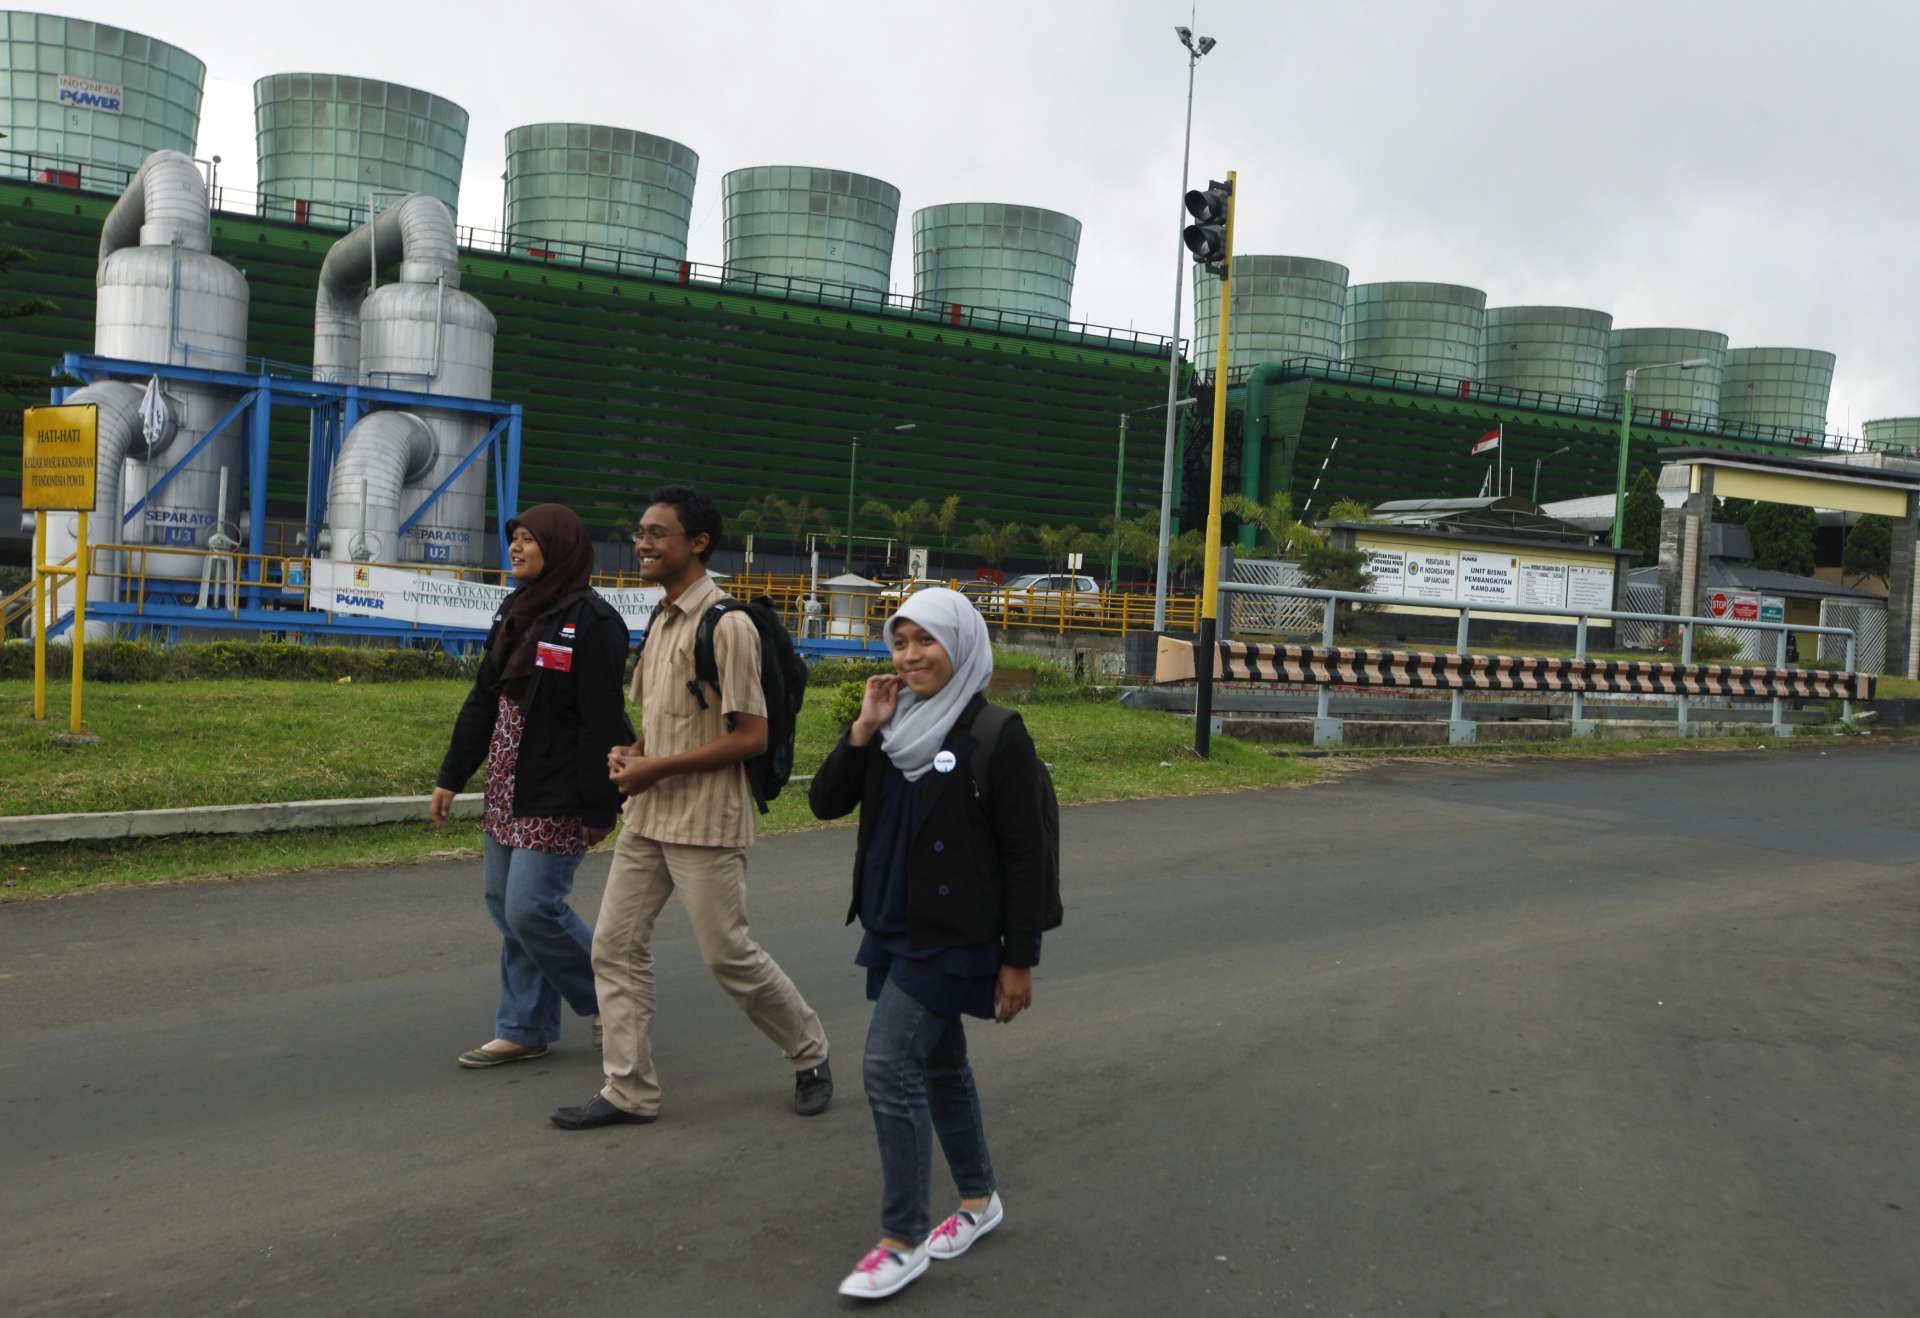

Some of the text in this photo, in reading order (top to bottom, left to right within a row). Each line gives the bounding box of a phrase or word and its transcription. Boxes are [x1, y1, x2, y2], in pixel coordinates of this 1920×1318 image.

[60, 78, 121, 97] INDONESIA
[60, 89, 120, 112] POWER
[38, 429, 80, 444] HATI-HATI
[146, 510, 217, 525] SEPARATO
[171, 529, 192, 543] U3
[429, 546, 447, 560] U2
[1470, 567, 1507, 577] UNIT BISNIS
[1464, 575, 1513, 585] PEMBANGKITAN
[336, 586, 386, 599] INDONESIA
[1470, 584, 1505, 594] KAMOJANG
[336, 594, 386, 609] POWER
[402, 590, 441, 606] UNTUK
[633, 592, 646, 604] K3
[1712, 600, 1727, 609] STOP
